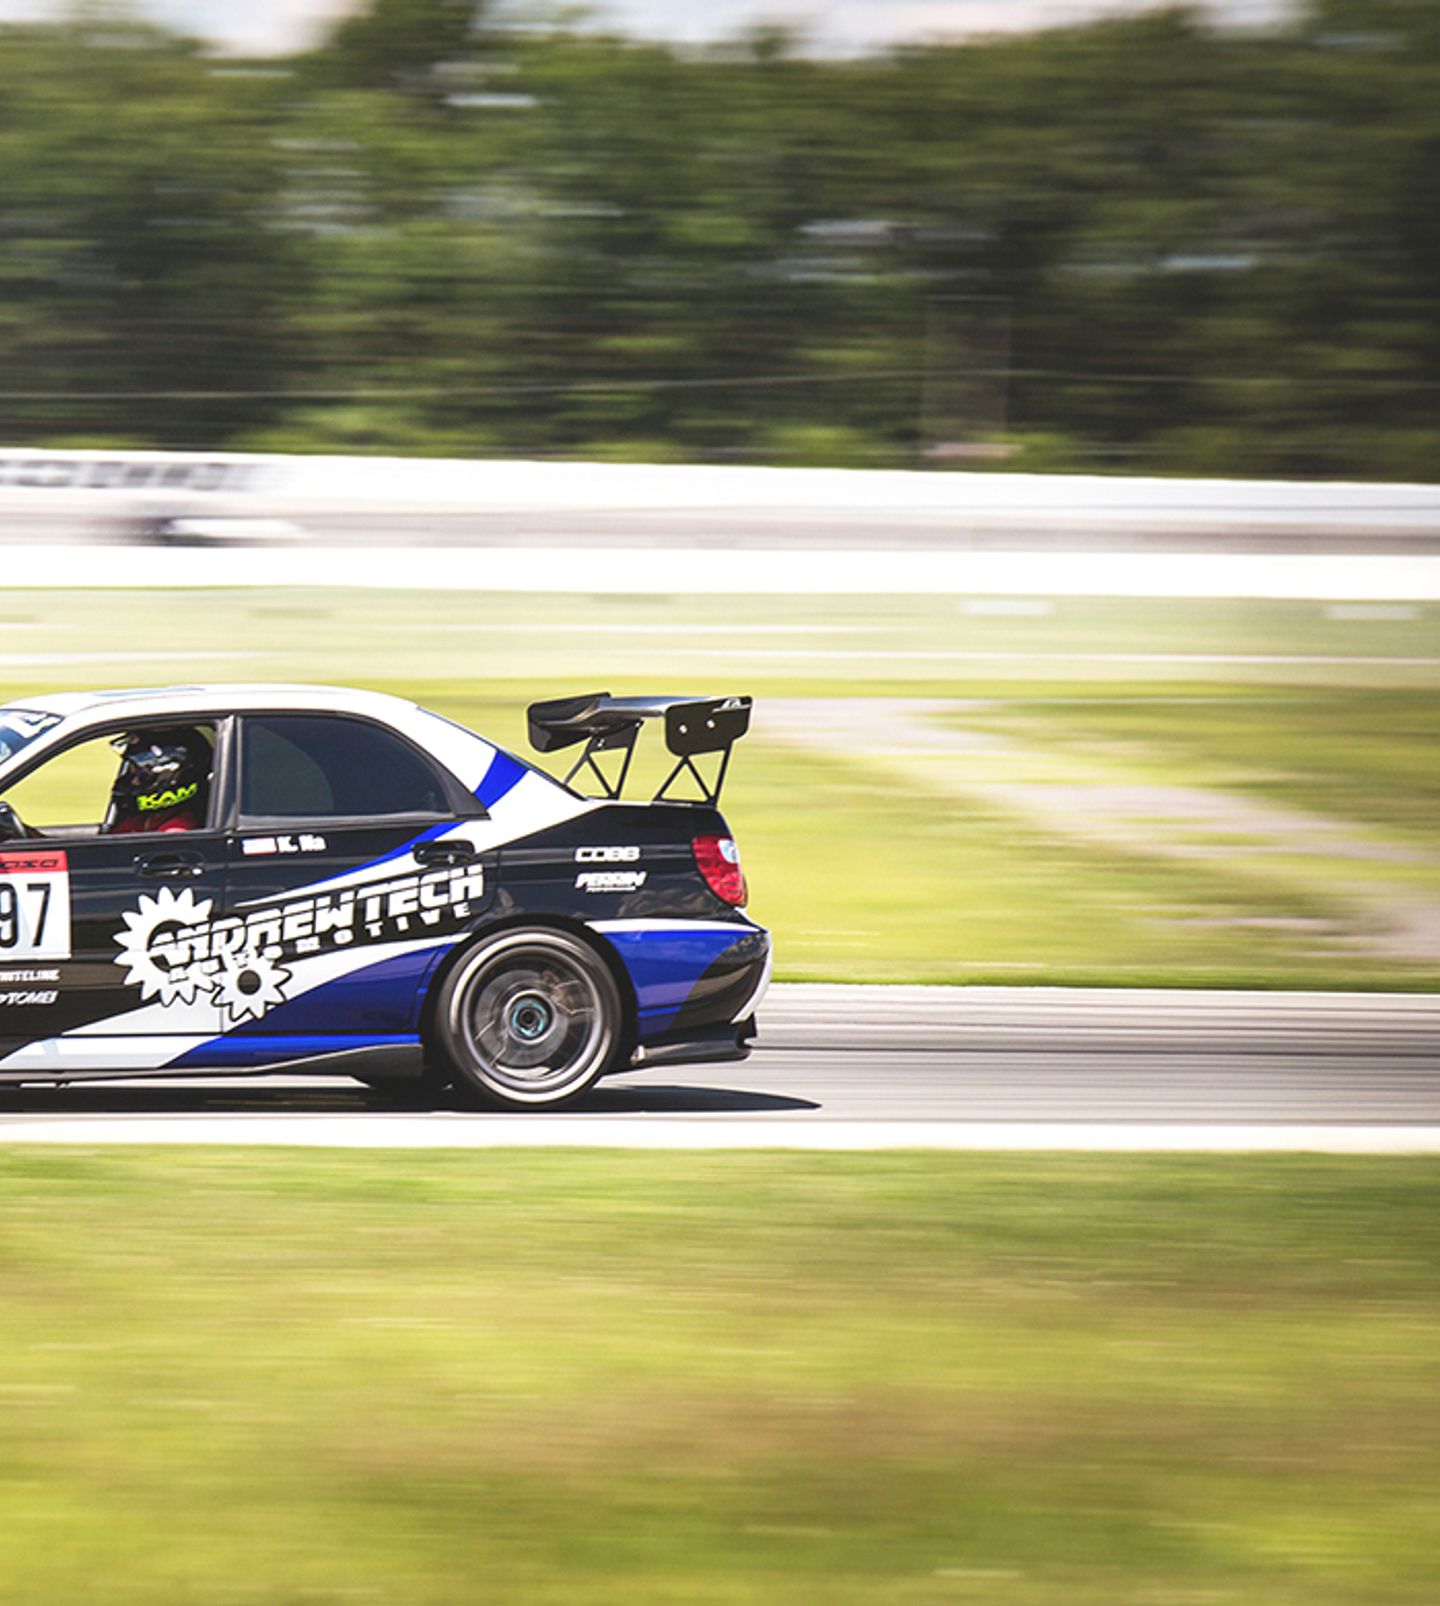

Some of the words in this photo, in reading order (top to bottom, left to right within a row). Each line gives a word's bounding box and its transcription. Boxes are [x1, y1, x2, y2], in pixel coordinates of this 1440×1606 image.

[575, 846, 640, 862] COBB
[148, 864, 483, 968] ANDREWTECH
[7, 991, 58, 1005] TOMEI
